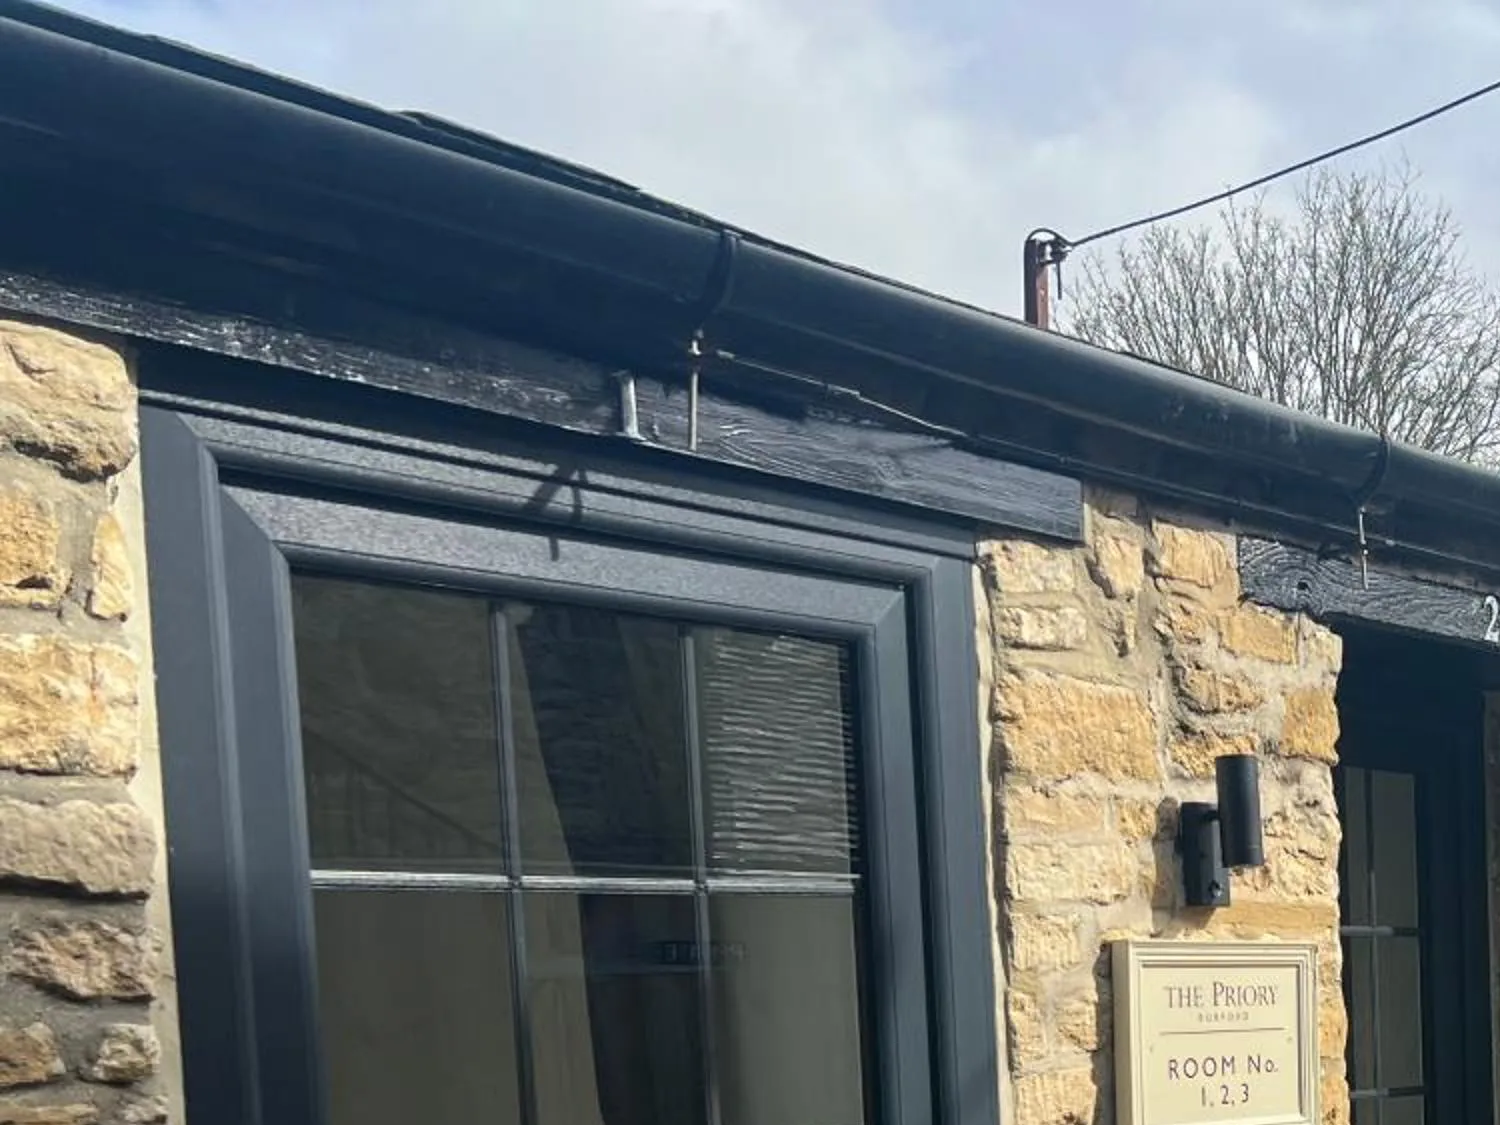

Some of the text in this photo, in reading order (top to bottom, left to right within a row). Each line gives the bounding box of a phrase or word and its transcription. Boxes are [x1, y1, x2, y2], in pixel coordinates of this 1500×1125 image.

[1483, 595, 1500, 642] 2
[1163, 984, 1204, 1008] THE
[1168, 1053, 1278, 1080] ROOM No.
